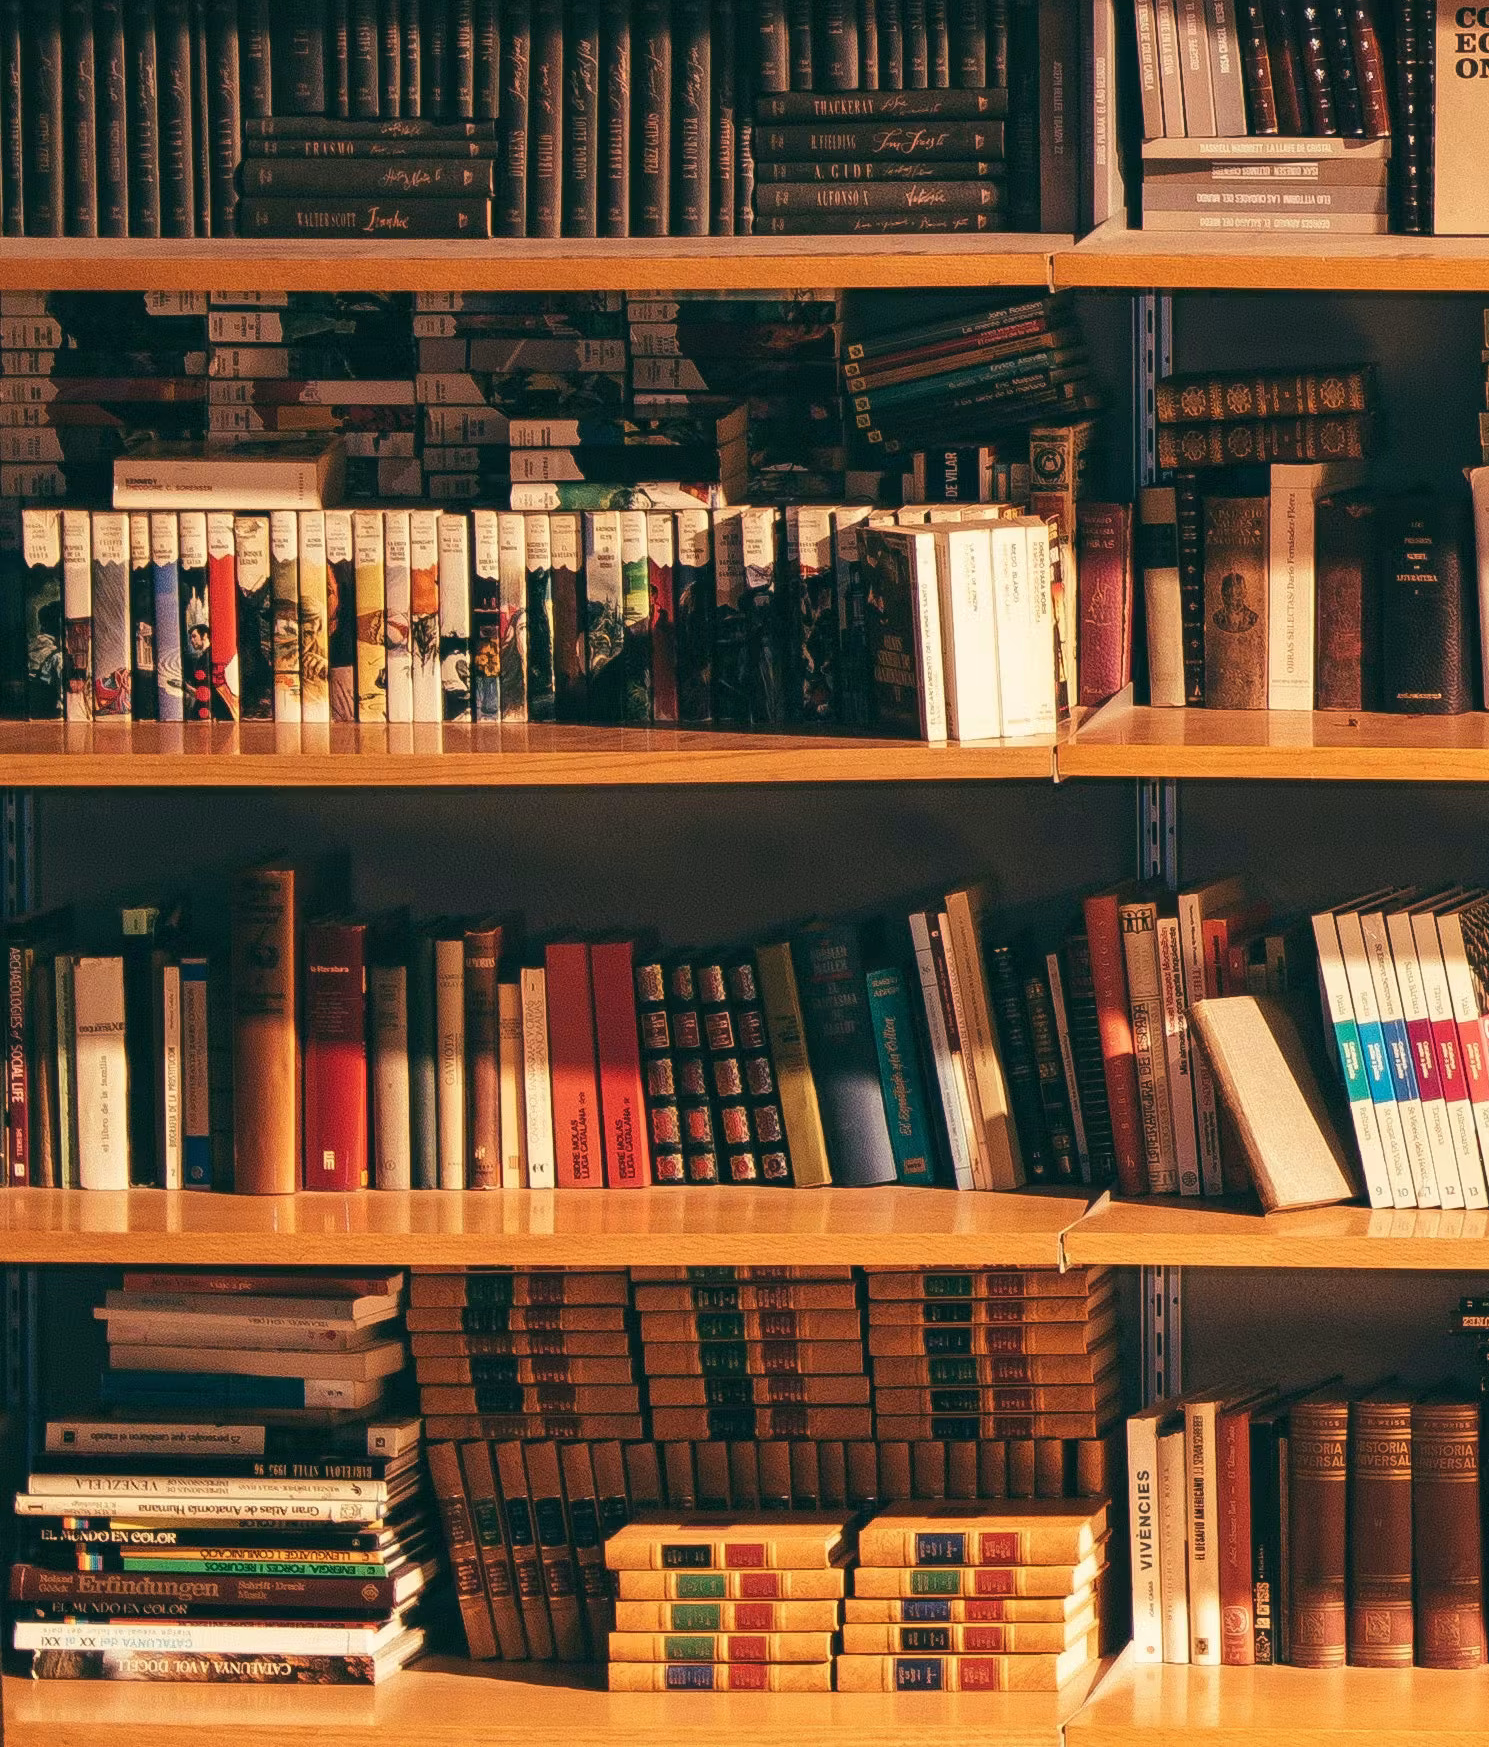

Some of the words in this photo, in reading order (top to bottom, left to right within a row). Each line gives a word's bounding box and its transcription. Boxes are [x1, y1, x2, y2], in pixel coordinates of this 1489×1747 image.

[813, 100, 874, 115] THACKERAY
[831, 163, 874, 179] GIDE
[76, 1478, 158, 1491] VENEZUELA
[42, 1530, 57, 1540] EL
[60, 1531, 109, 1542] MUNDO
[111, 1531, 129, 1542] EN
[131, 1532, 182, 1543] COLOR
[75, 1575, 220, 1601] Erfindungen
